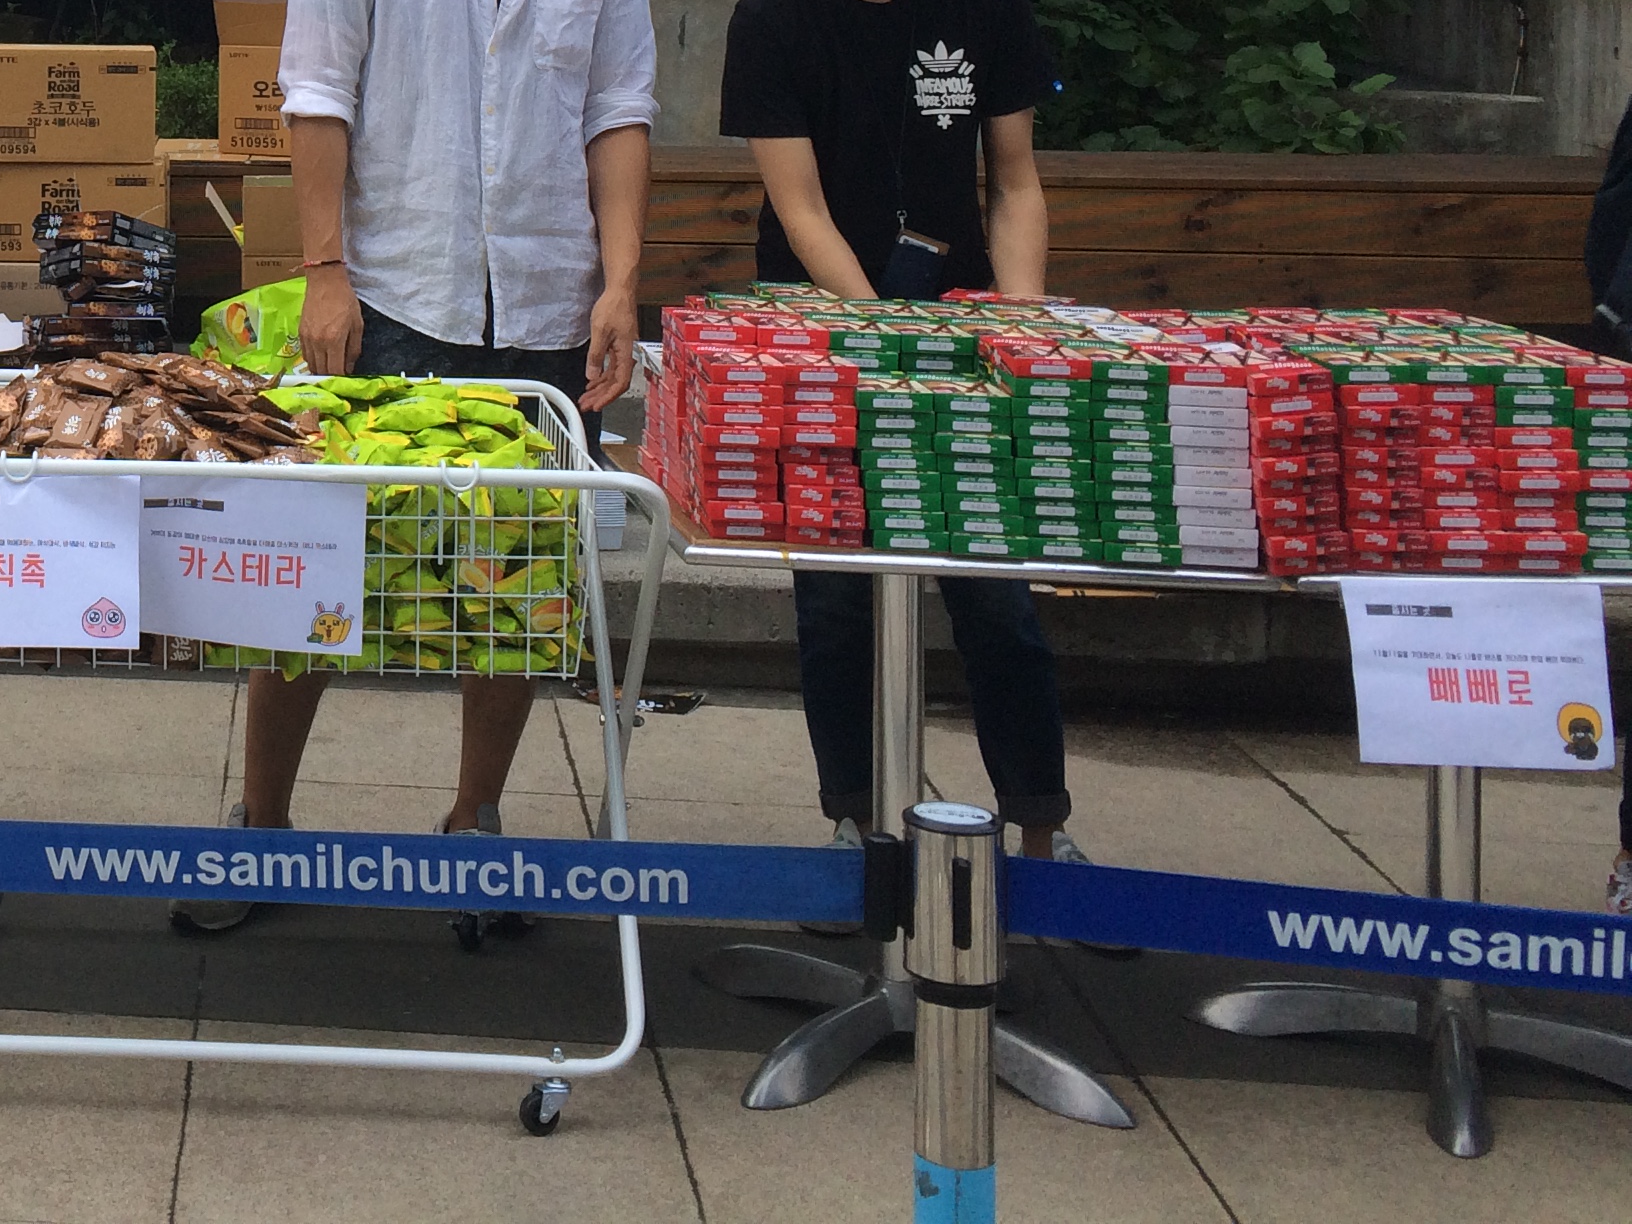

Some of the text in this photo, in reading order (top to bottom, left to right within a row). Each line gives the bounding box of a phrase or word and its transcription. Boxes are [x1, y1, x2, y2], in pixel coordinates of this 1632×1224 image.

[48, 66, 81, 78] Farm
[48, 81, 80, 93] Road
[915, 77, 974, 94] INFAMOUS
[31, 101, 97, 117] 초코호두
[231, 137, 284, 148] 5109591
[41, 183, 81, 198] Farm
[41, 200, 80, 214] Road
[179, 545, 306, 588] 카스테라
[1427, 667, 1533, 705] 빼빼로
[45, 843, 689, 904] www.samilchurch.com
[1268, 909, 1632, 980] www.samil
